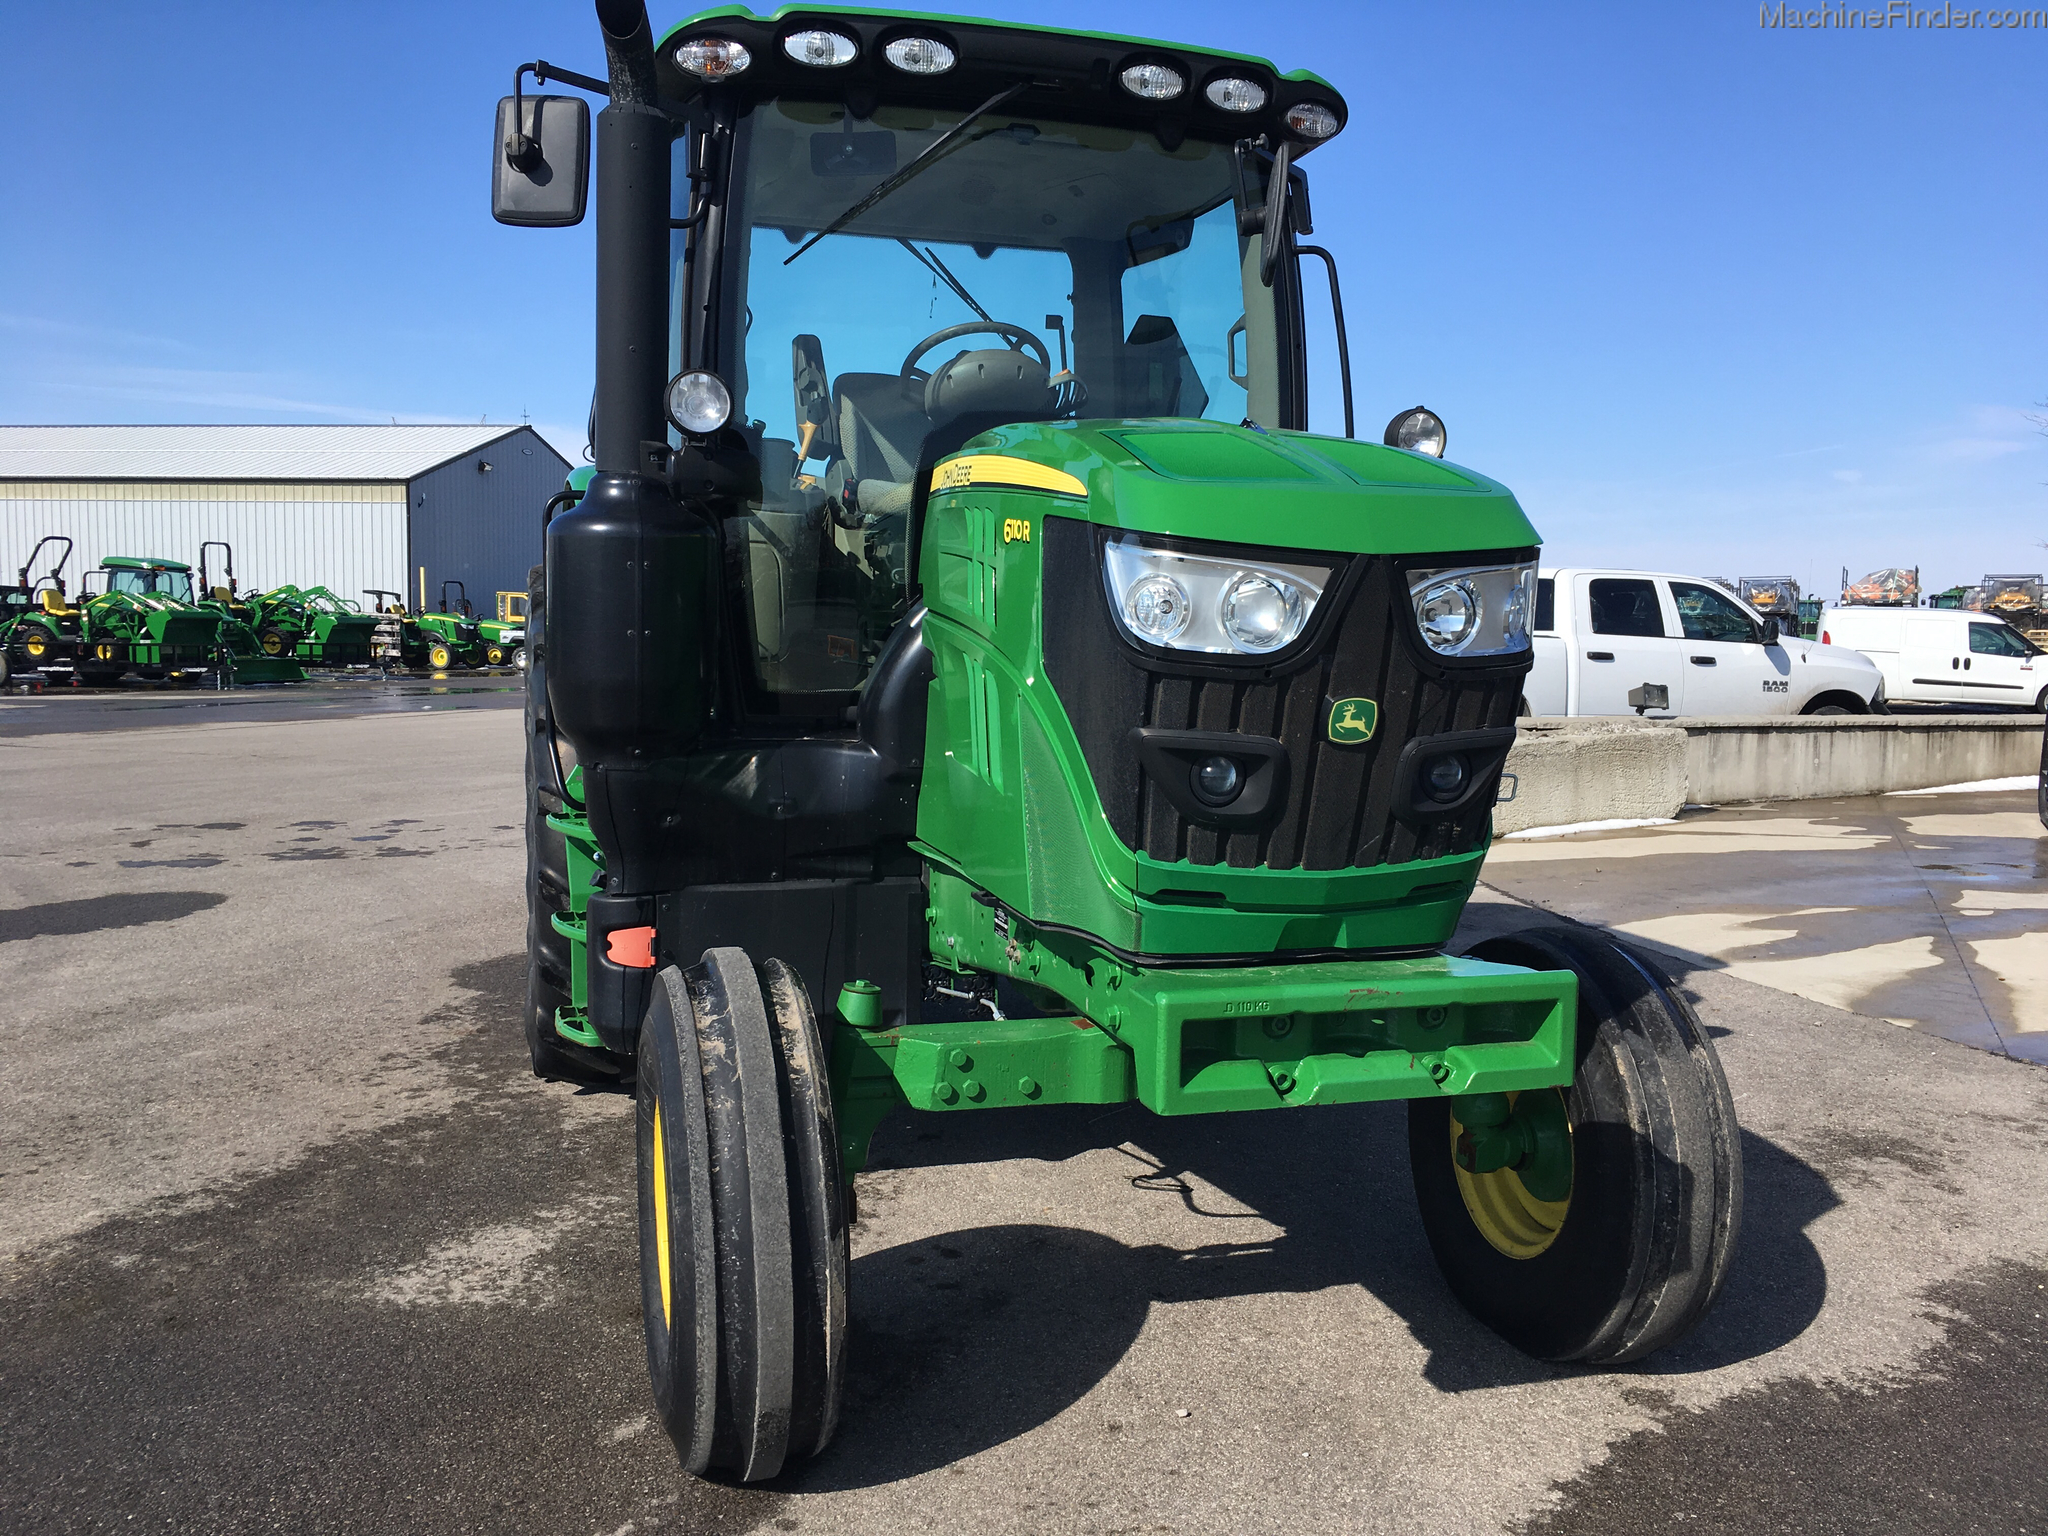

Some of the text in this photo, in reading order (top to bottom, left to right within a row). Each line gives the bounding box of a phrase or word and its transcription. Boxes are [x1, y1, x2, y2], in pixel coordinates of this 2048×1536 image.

[953, 463, 972, 486] DEERE
[1237, 1001, 1253, 1013] 110
[1255, 1000, 1270, 1012] KG
